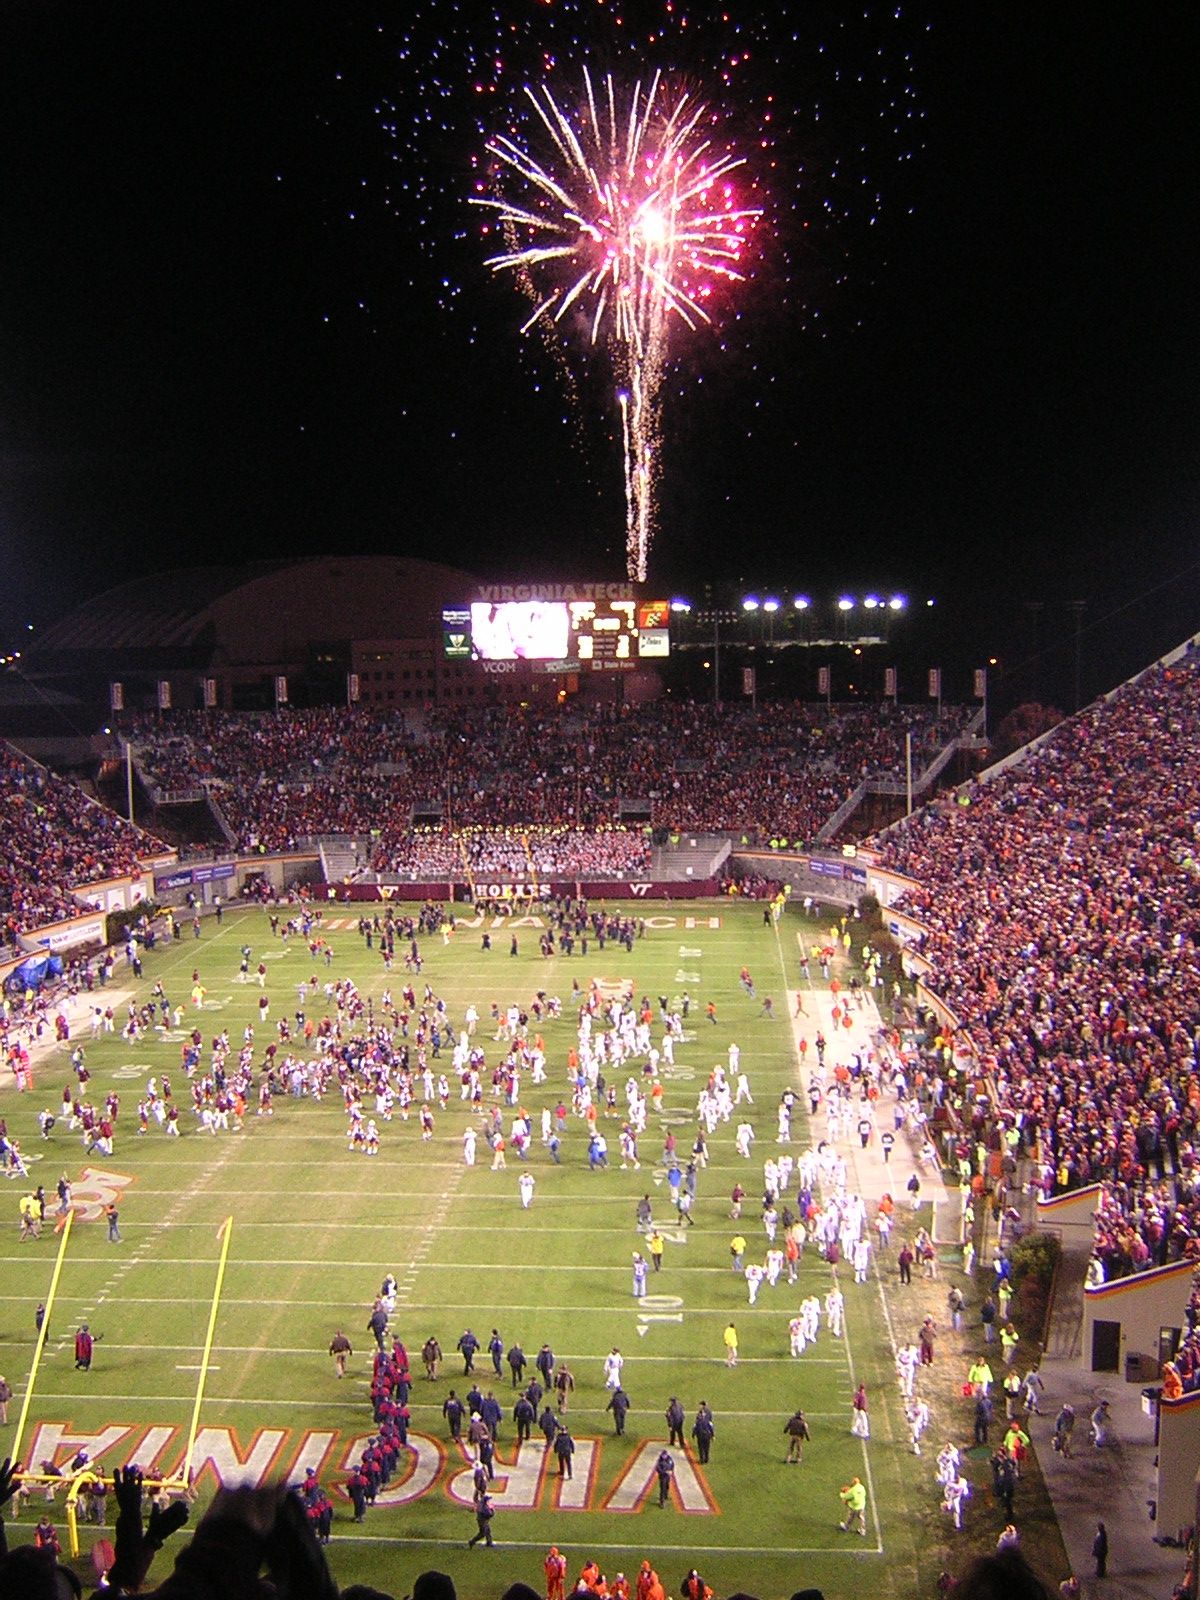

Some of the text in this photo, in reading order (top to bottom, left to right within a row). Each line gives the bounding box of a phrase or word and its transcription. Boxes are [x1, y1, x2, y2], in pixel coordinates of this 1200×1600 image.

[478, 582, 634, 600] VIRGINIA TECH
[482, 661, 517, 673] VCOM
[629, 883, 653, 896] VT
